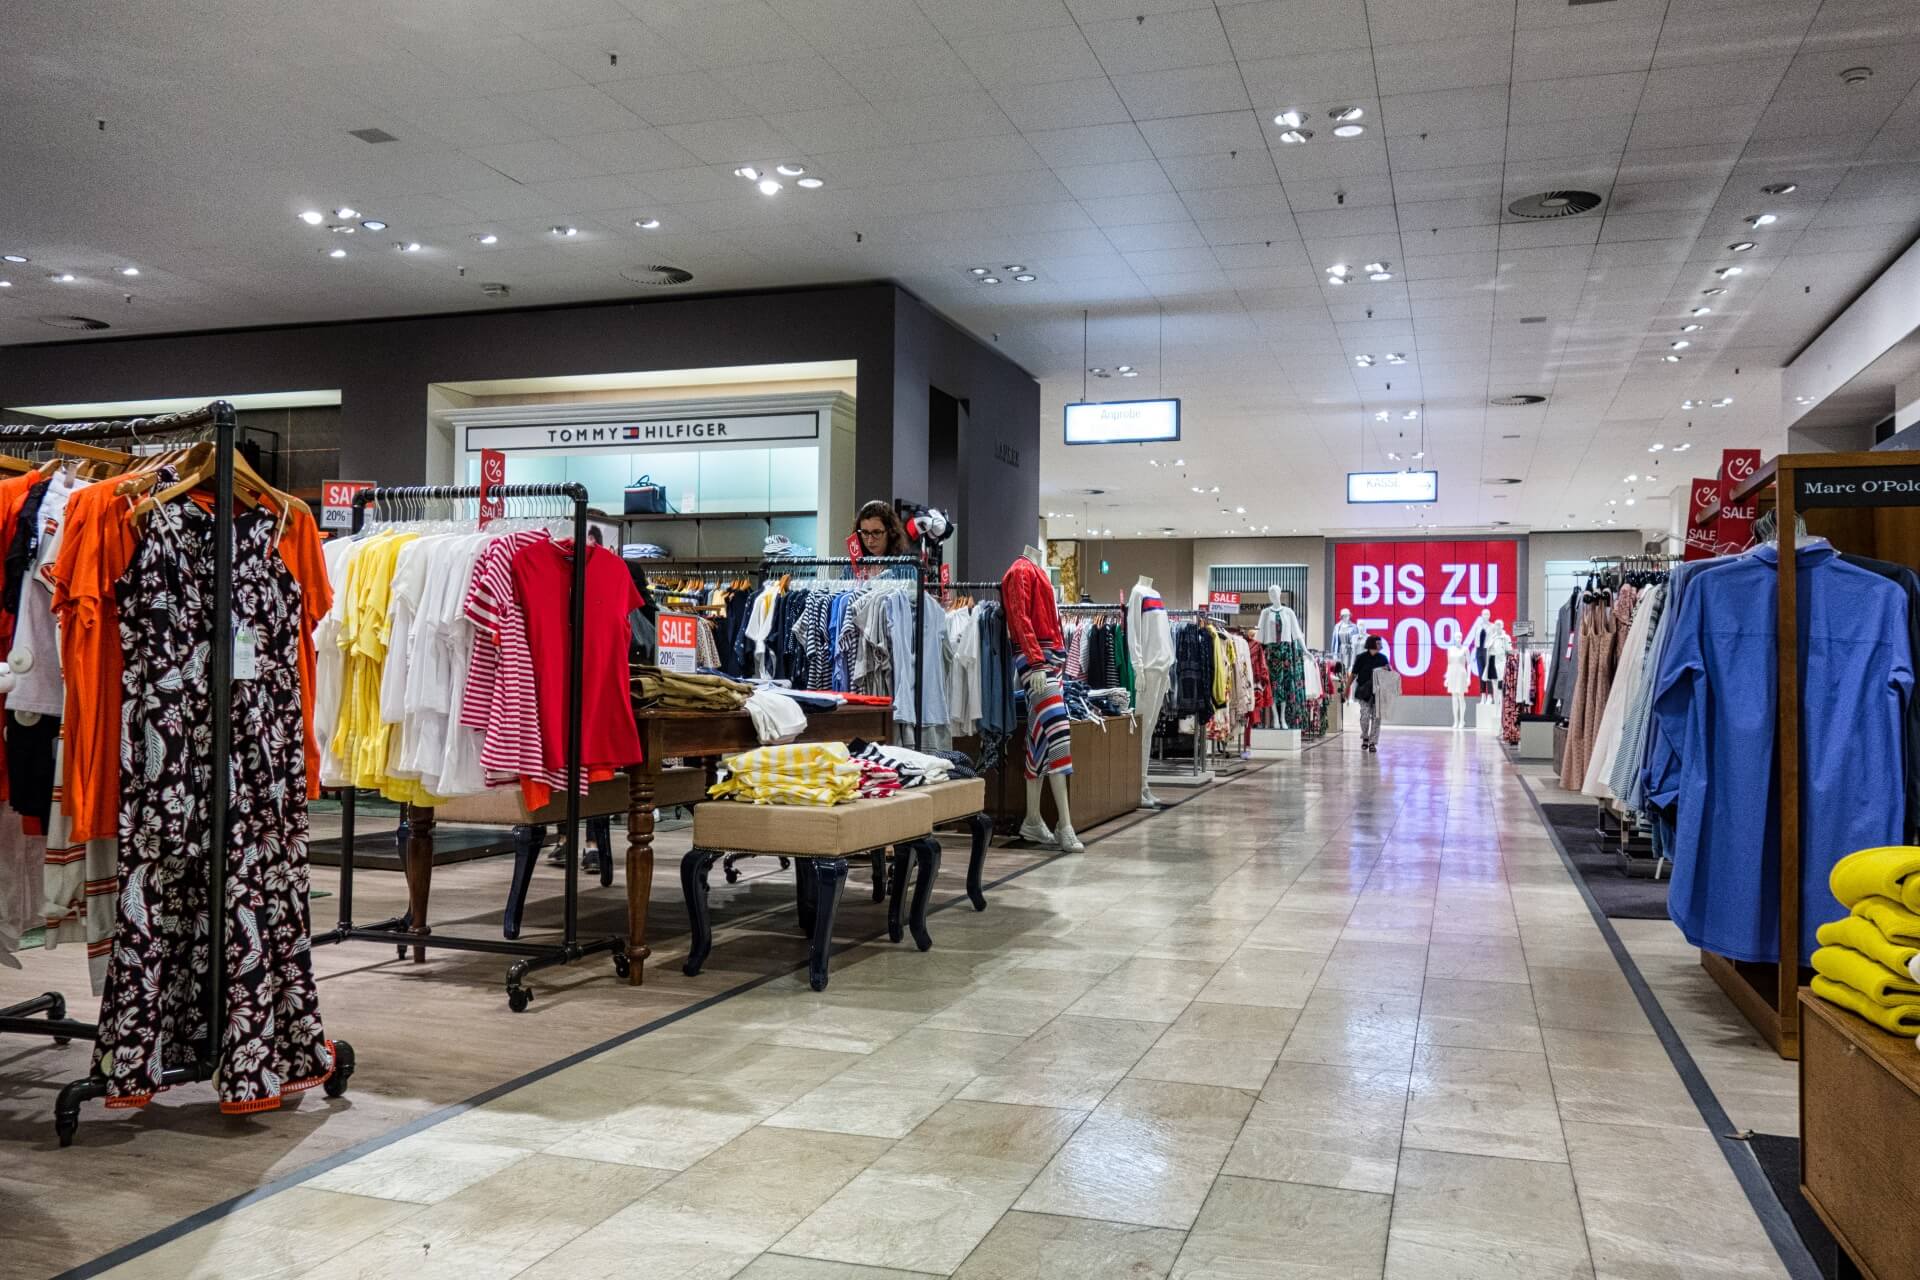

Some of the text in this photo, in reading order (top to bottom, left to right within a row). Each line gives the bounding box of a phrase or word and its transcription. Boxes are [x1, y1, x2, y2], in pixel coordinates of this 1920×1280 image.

[548, 423, 727, 442] TOMMY HILFIGER
[1804, 482, 1856, 494] Marc
[329, 485, 369, 505] SA
[326, 510, 346, 522] 20%
[1722, 506, 1755, 519] SALE
[1688, 528, 1717, 541] SALE
[1353, 563, 1498, 606] BIS ZU
[1214, 592, 1237, 603] SALE
[1239, 603, 1259, 611] ERRY
[662, 620, 692, 644] SALE
[660, 651, 675, 666] 20%
